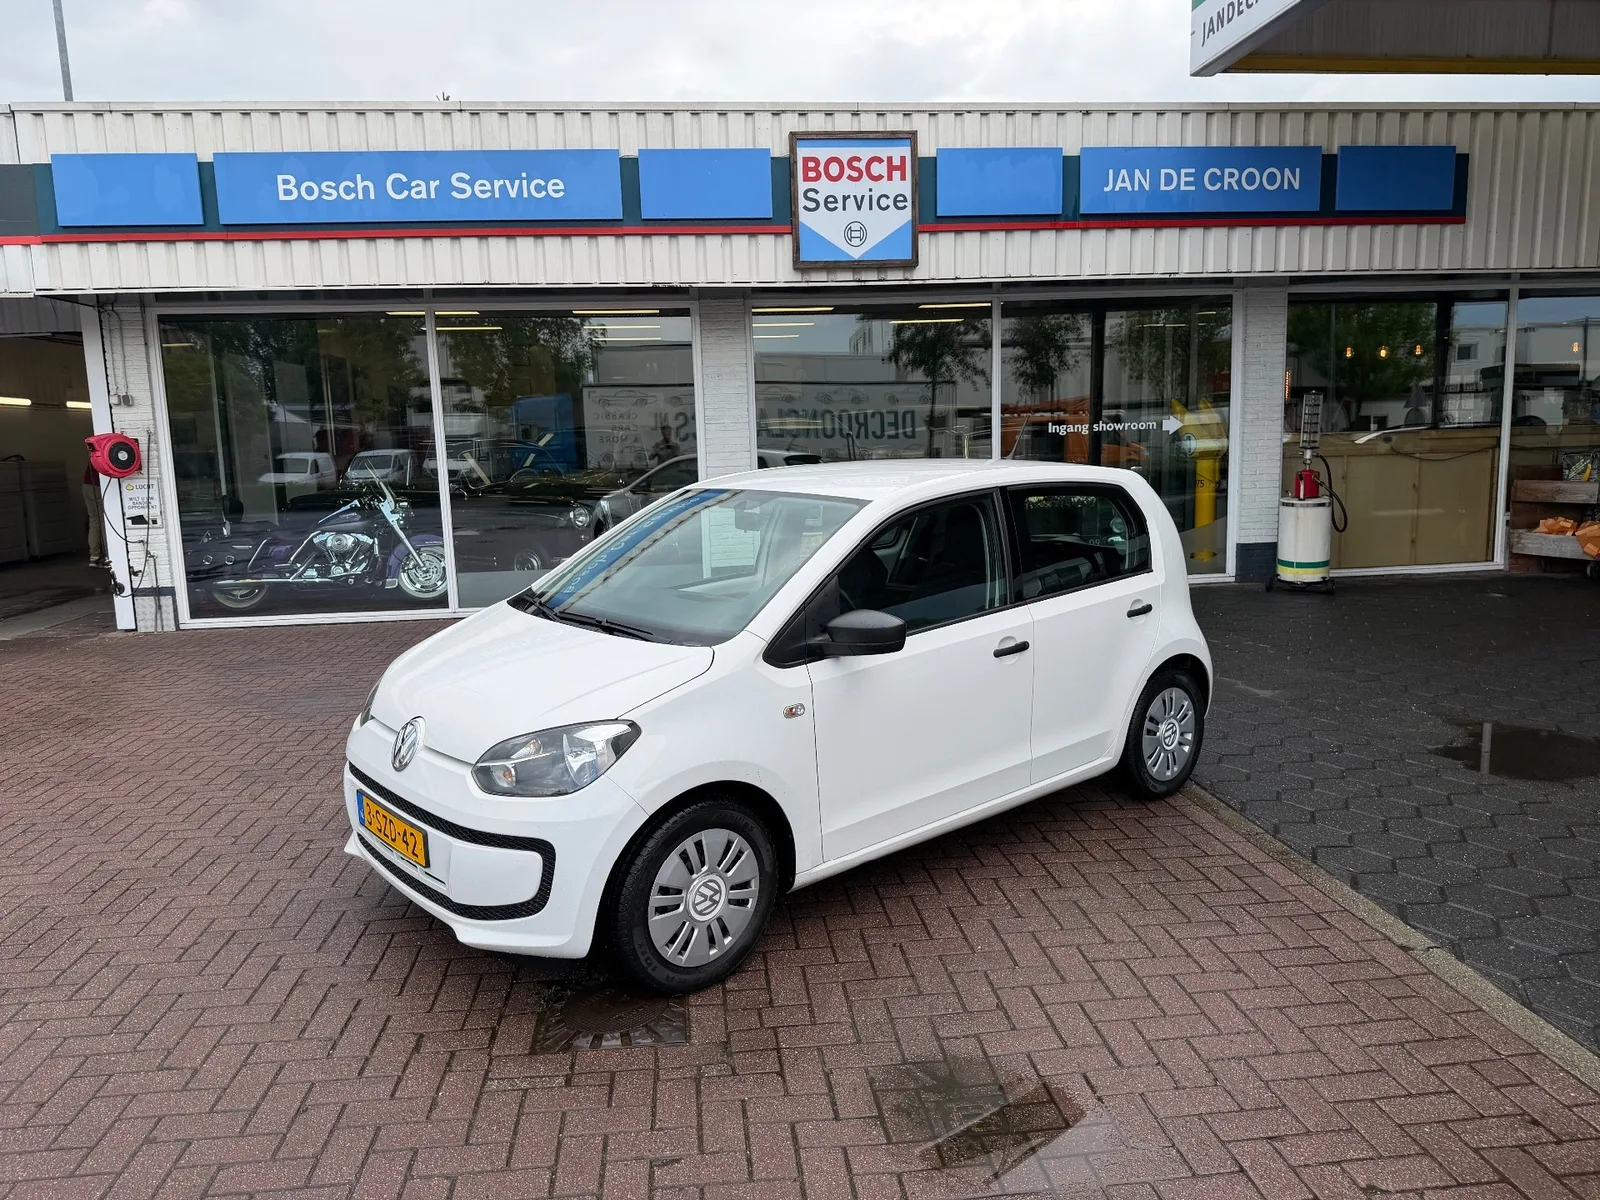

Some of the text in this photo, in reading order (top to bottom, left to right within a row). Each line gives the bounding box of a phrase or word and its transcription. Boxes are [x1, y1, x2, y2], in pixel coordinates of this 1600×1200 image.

[1201, 0, 1259, 47] JANDEC
[802, 155, 906, 182] BOSCH
[1104, 167, 1300, 191] JAN DE CROON
[276, 171, 566, 201] Bosch Car Service
[802, 187, 908, 212] Service
[1048, 420, 1157, 435] Ingang showroom
[365, 802, 419, 859] 3-SZD-42
